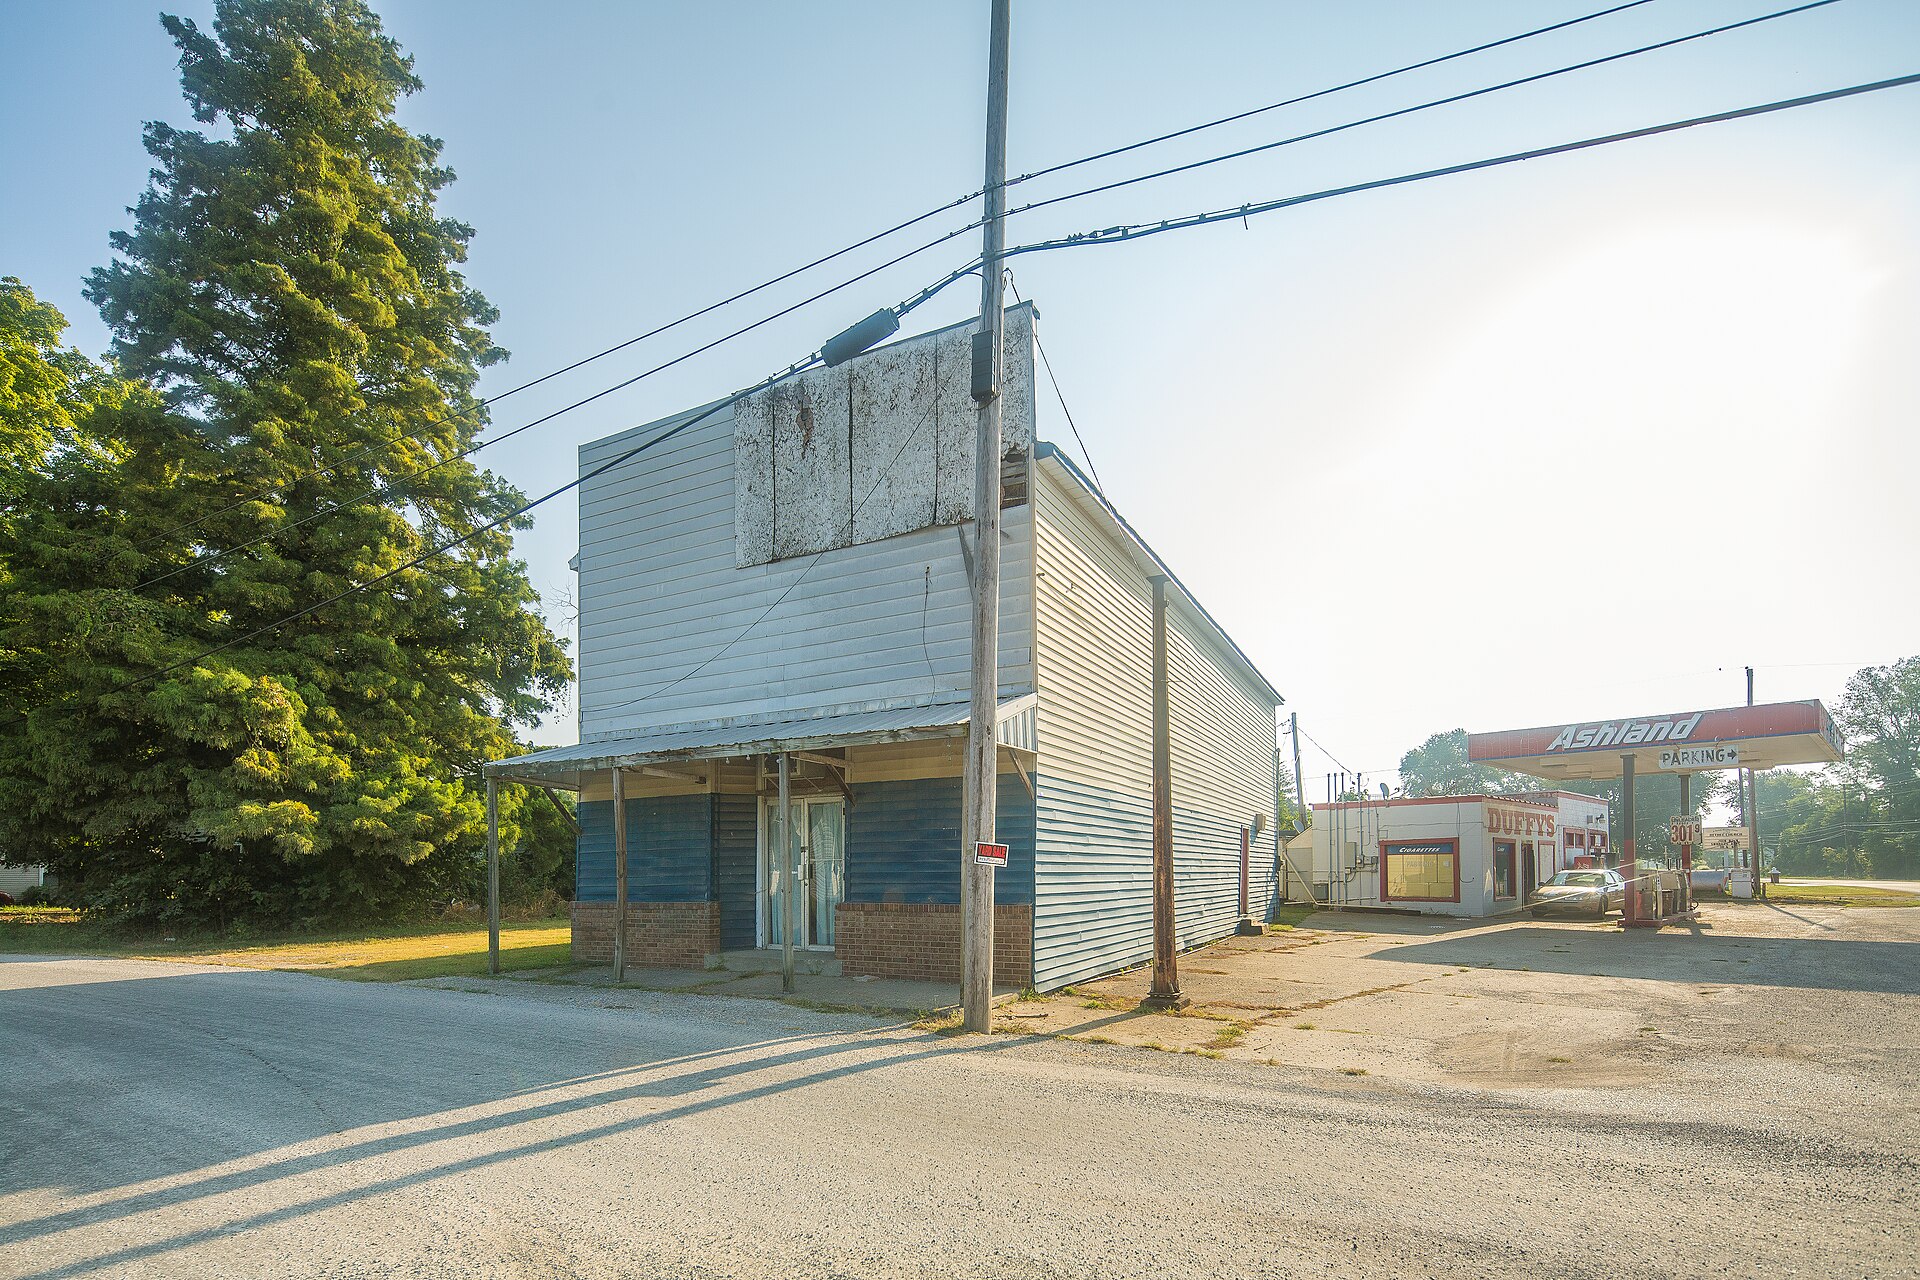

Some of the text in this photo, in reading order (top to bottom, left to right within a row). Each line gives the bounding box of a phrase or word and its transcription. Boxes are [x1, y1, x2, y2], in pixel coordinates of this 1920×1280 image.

[1546, 713, 1702, 750] Ashland
[1662, 750, 1725, 766] PARKING
[1488, 808, 1555, 837] DUFFY'S
[978, 844, 1006, 858] YARD SALE
